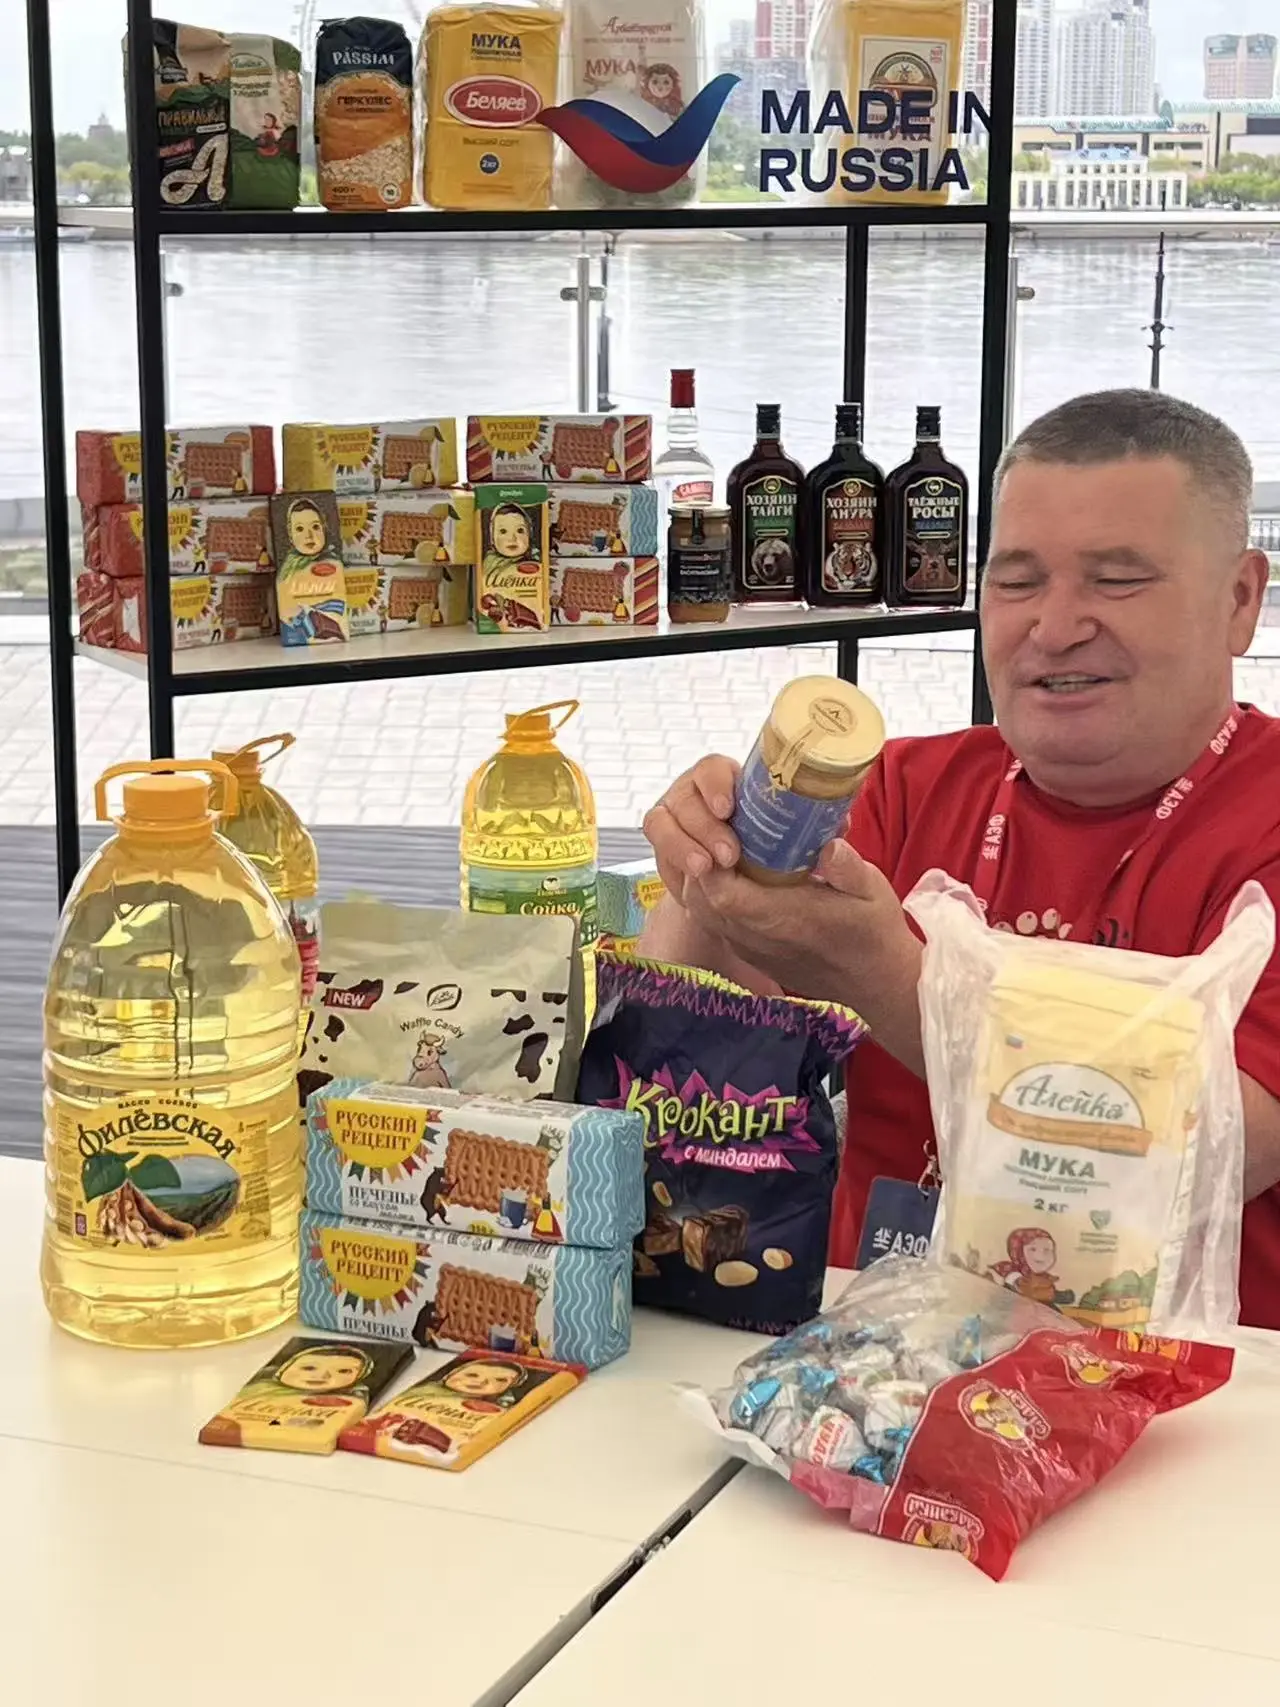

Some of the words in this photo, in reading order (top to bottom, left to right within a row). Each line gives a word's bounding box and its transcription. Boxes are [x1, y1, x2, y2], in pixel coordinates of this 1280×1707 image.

[472, 33, 520, 49] МУКА
[585, 58, 637, 77] МУКА
[466, 92, 527, 112] Беляев
[761, 89, 934, 135] MADE
[759, 147, 970, 193] RUSSIA
[746, 494, 798, 505] ХОЗЯИН
[750, 504, 794, 517] ТАЙГИ
[826, 497, 877, 508] ХОЗЯИН
[907, 496, 961, 507] ТАЁЖНЫЕ
[830, 508, 873, 519] АМУРА
[911, 506, 956, 519] РОСЫ
[520, 899, 577, 916] Сойка
[332, 991, 367, 1007] NEW
[399, 1016, 433, 1033] Waffle
[434, 1017, 465, 1040] Candy
[1015, 1074, 1124, 1121] Алейка
[336, 1109, 418, 1135] РУССКИЙ
[625, 1076, 797, 1148] Крокант
[78, 1107, 236, 1161] Филёвская
[341, 1128, 412, 1152] РЕЦЕПТ
[695, 1147, 782, 1169] миндалем
[1019, 1147, 1096, 1179] МУКА
[349, 1185, 419, 1207] ПЕЧЕНЬЕ
[1033, 1197, 1046, 1211] 2
[330, 1239, 410, 1267] РУССКИЙ
[335, 1257, 405, 1283] РЕЦЕПТ
[343, 1316, 409, 1338] ПЕЧЕНЬЕ
